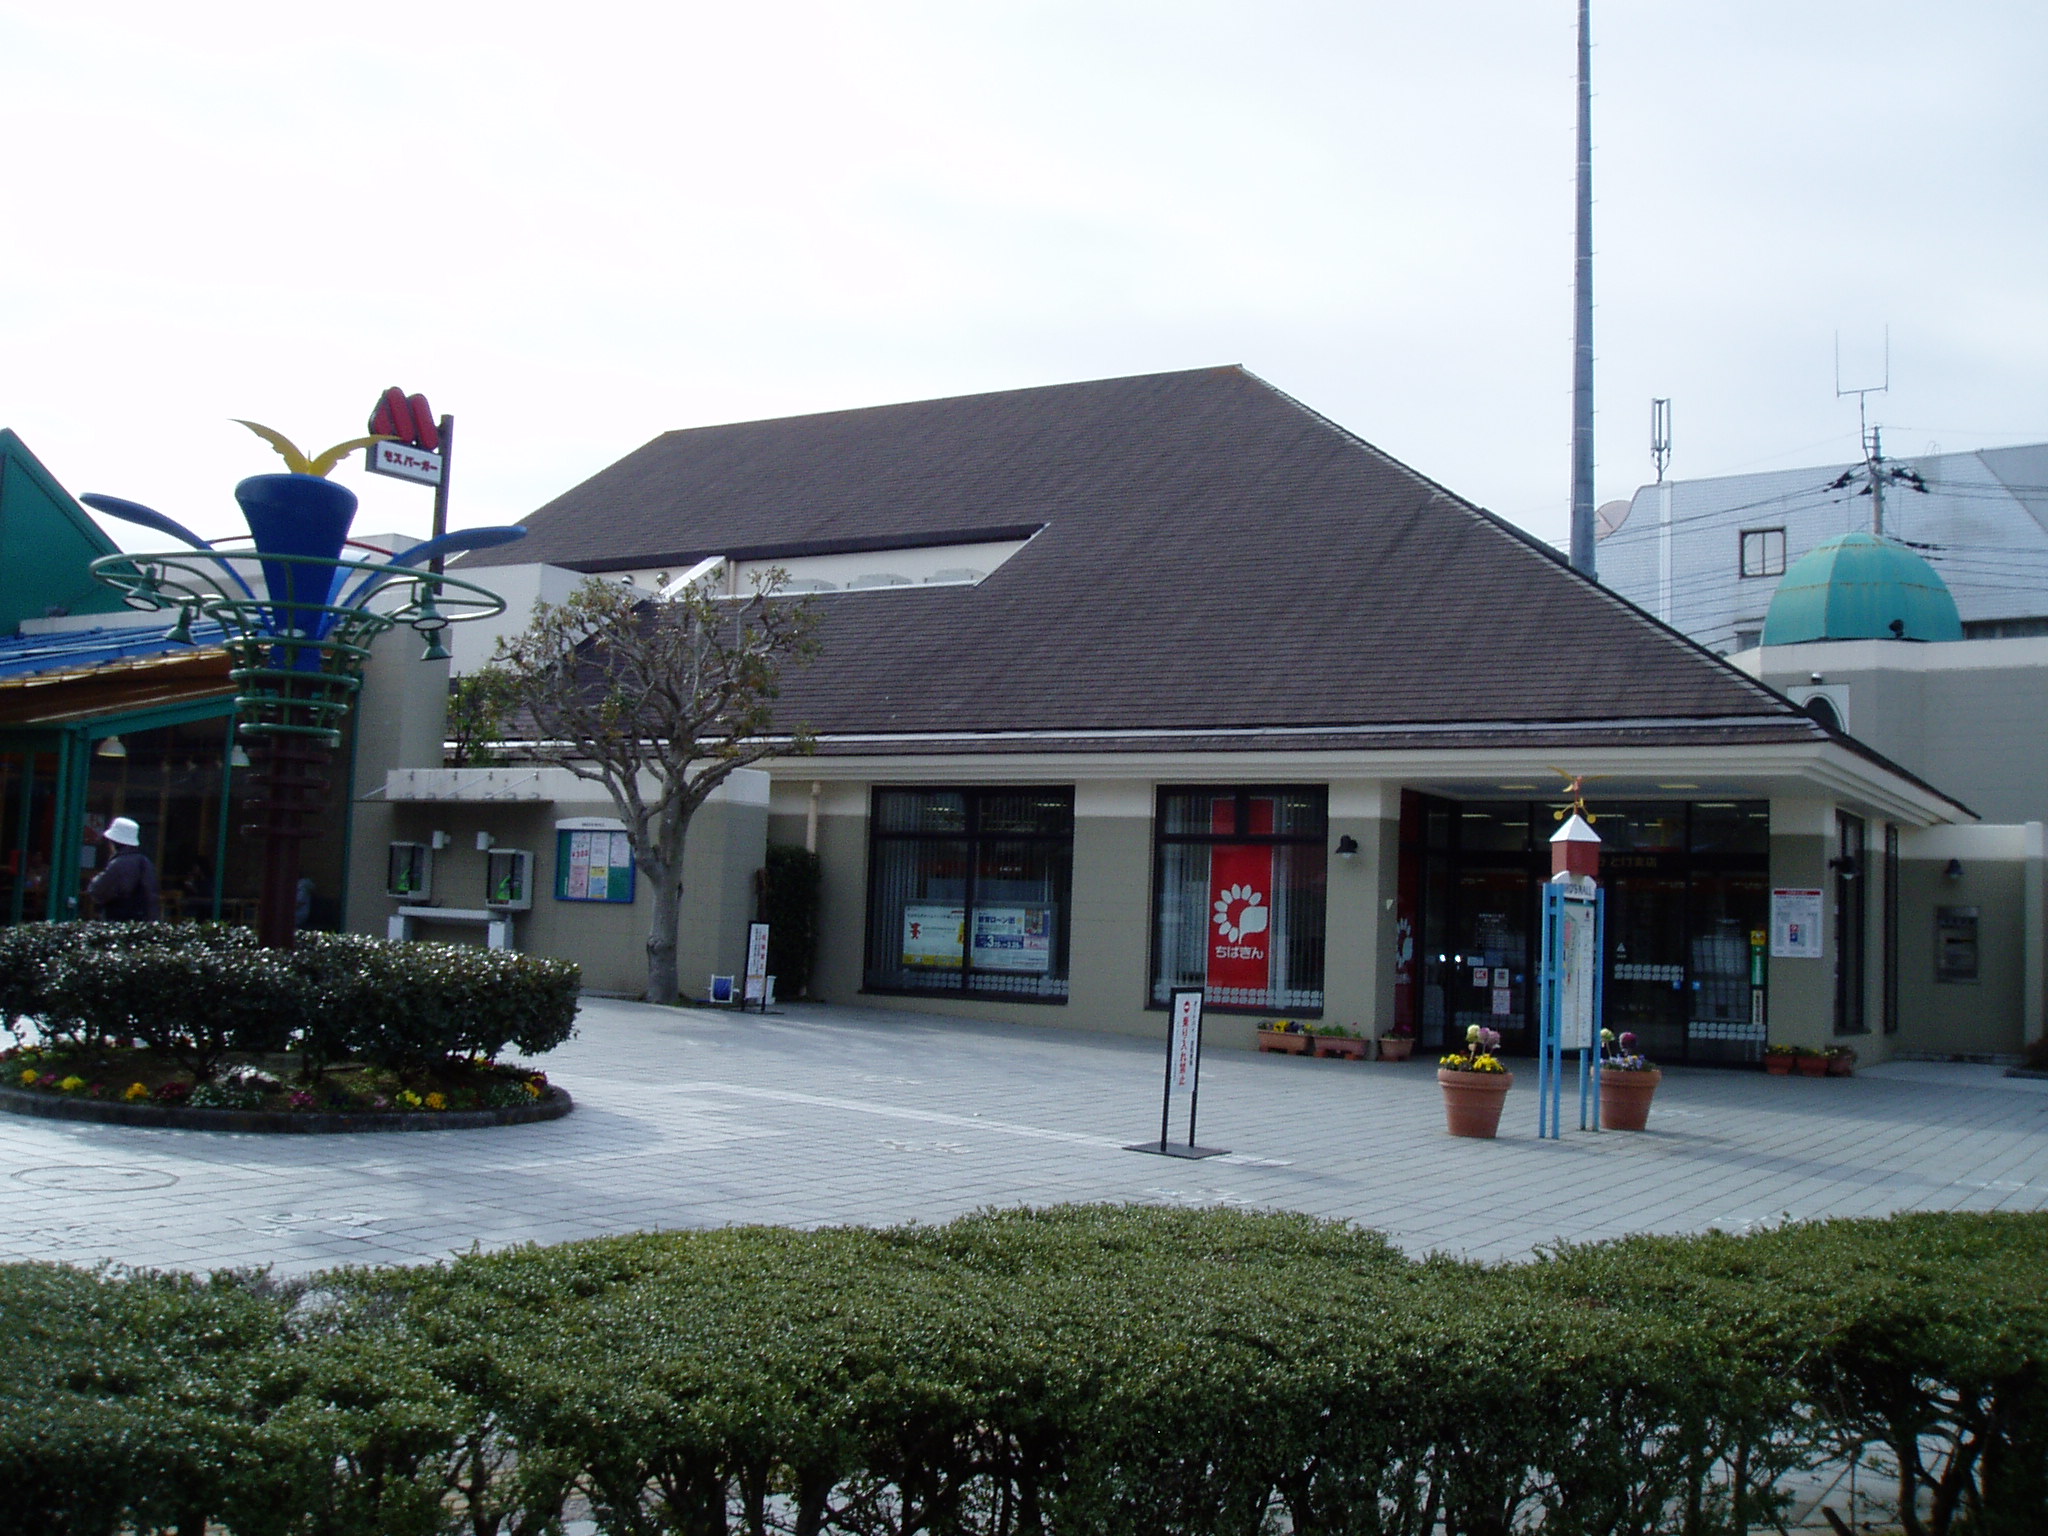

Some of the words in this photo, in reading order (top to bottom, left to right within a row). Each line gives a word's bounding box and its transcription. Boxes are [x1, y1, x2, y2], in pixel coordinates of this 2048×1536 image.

[383, 450, 438, 472] モスバーガー
